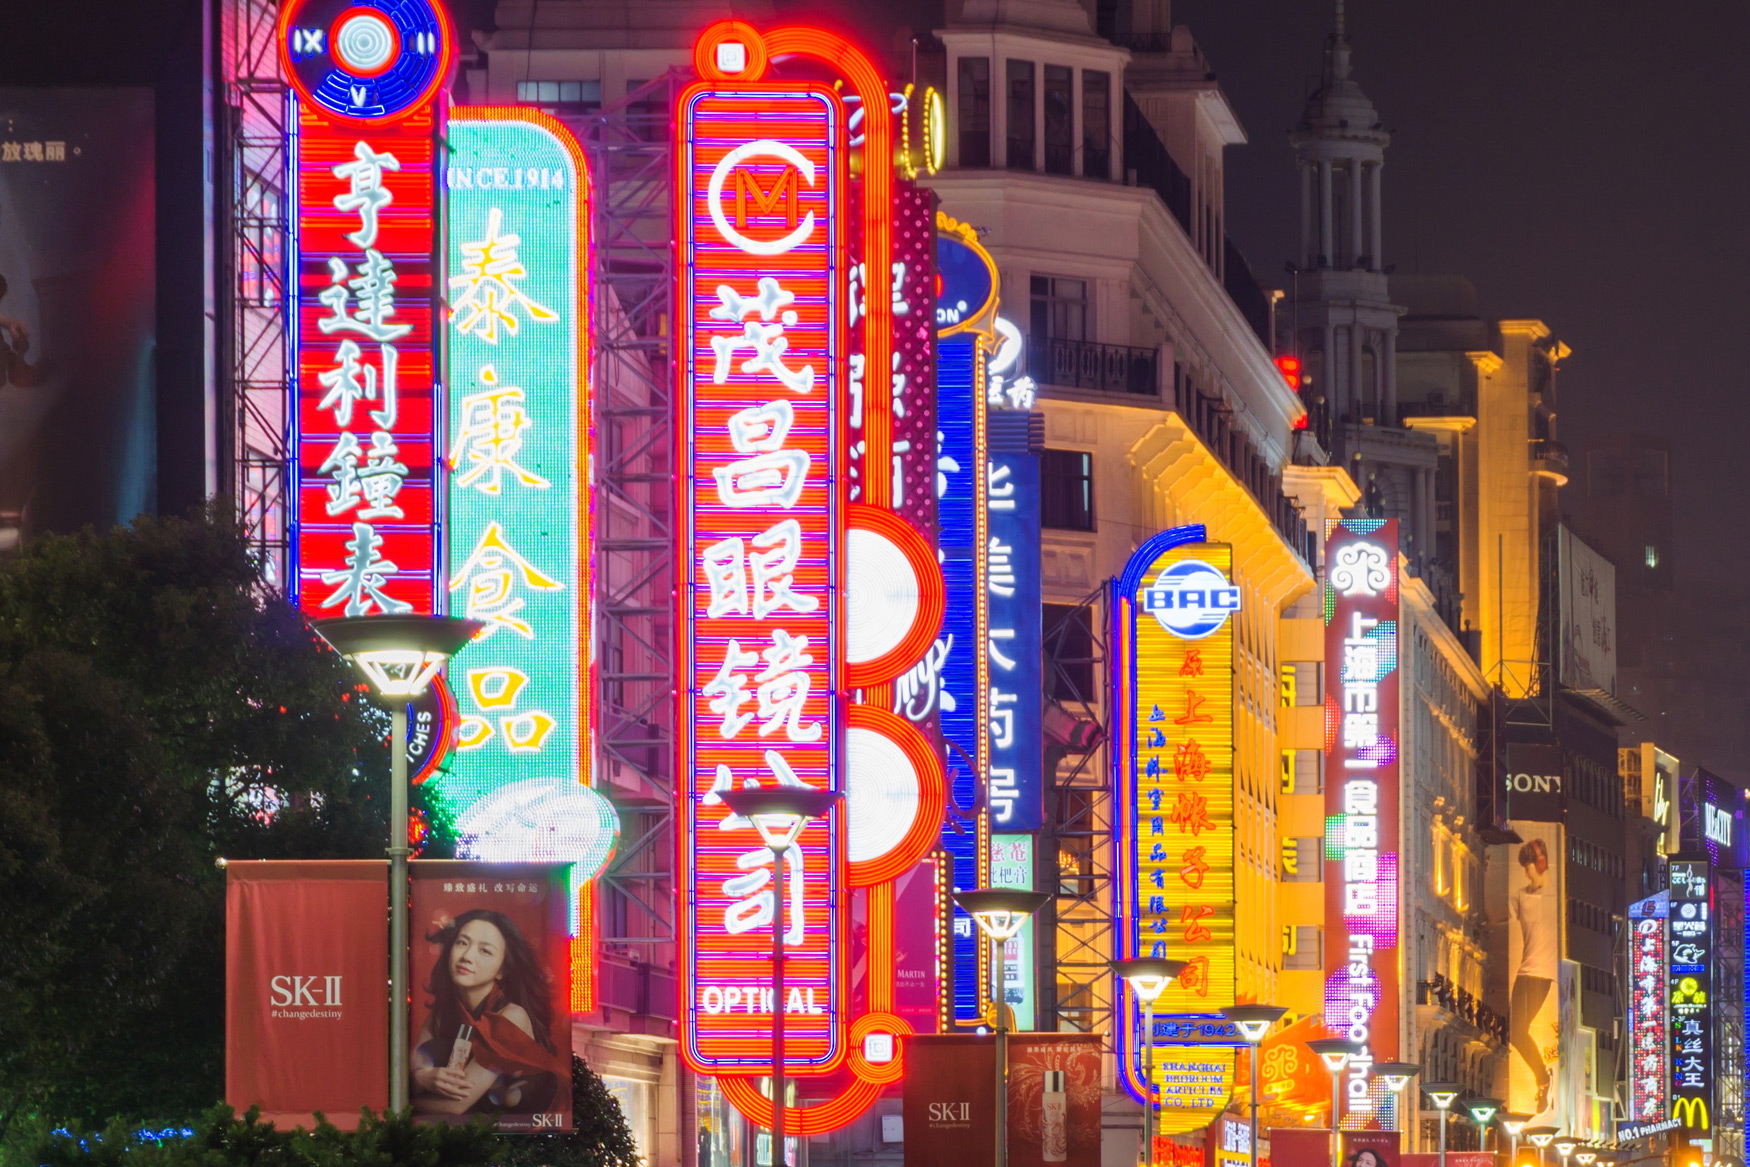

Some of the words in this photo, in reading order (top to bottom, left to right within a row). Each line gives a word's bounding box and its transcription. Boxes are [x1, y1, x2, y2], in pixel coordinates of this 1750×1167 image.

[448, 207, 566, 752] 泰康食品
[1146, 588, 1240, 611] BAC
[702, 277, 822, 946] 茂昌眼镜公司
[1349, 934, 1374, 985] First
[270, 975, 343, 1006] SK-II
[271, 1008, 343, 1020] #changedestiny
[1674, 1022, 1683, 1051] SILK
[1681, 1019, 1704, 1087] 真丝大王
[1162, 1062, 1226, 1073] SHANGHAI
[1674, 1058, 1683, 1087] KING
[1164, 1074, 1224, 1084] BEDROOM
[1165, 1085, 1223, 1096] ARTICLES
[929, 1102, 971, 1122] SK-II
[1191, 1097, 1214, 1108] LTD
[532, 1113, 563, 1127] SK-II
[1639, 1117, 1682, 1137] PHARMACY
